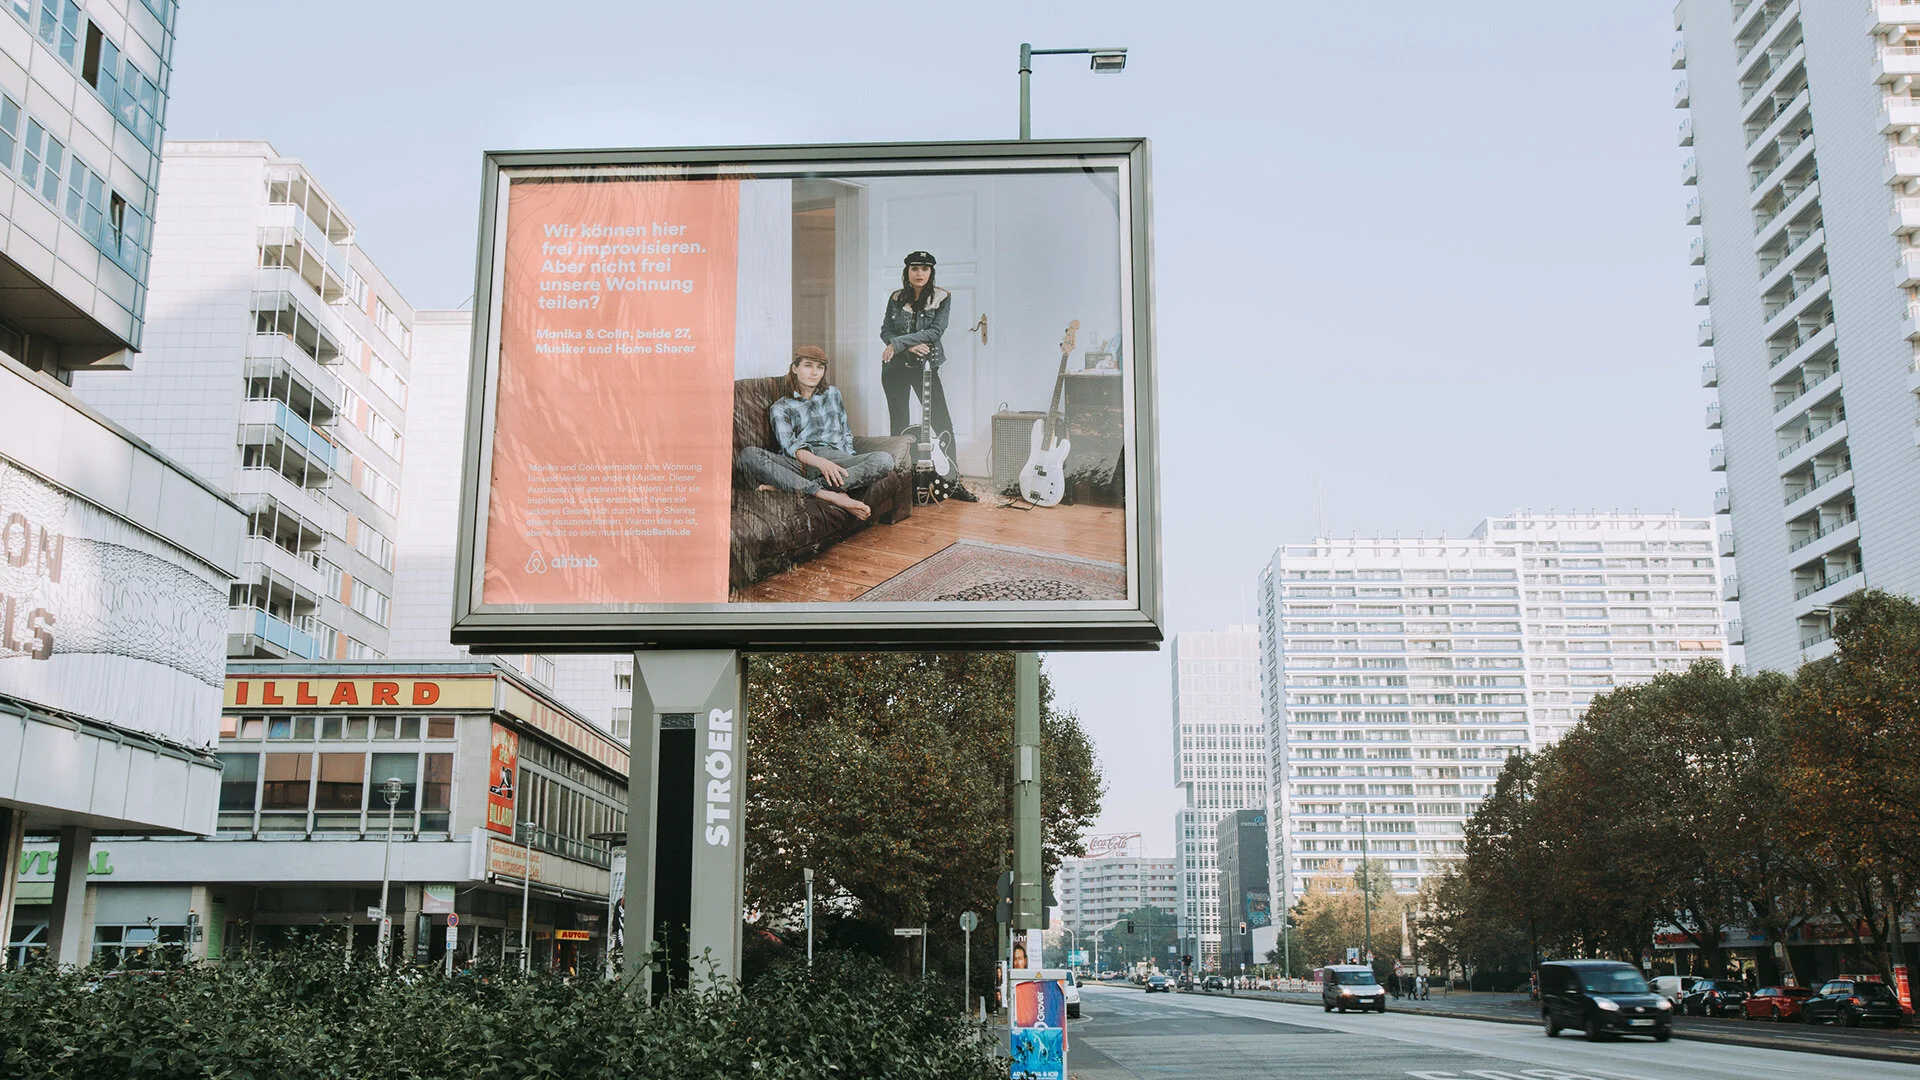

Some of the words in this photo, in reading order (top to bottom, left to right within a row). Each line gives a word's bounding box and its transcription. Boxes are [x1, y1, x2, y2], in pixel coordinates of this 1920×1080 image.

[543, 223, 577, 238] Wir
[580, 223, 646, 237] können
[652, 222, 687, 236] hier
[542, 241, 573, 255] frei
[577, 240, 707, 258] improvisieren.
[540, 259, 586, 273] Aber
[590, 258, 636, 273] nicht
[641, 258, 671, 272] frei
[539, 280, 601, 291] unsere
[606, 277, 693, 293] Wohnung
[537, 295, 600, 309] teilen?
[536, 328, 582, 339] Monika
[585, 329, 594, 339] &
[597, 329, 634, 340] Colin,
[637, 329, 672, 339] beide
[674, 328, 692, 340] 27,
[535, 343, 586, 354] Musiker
[589, 344, 612, 354] und
[615, 343, 652, 354] Home
[655, 343, 696, 353] Sharer
[578, 463, 600, 471] Colin
[662, 463, 703, 472] Wohnung
[669, 473, 695, 481] Dieser
[664, 506, 696, 516] Sharing
[551, 554, 599, 568] airbnb
[0, 592, 56, 661] LS
[705, 708, 733, 847] STRÖER
[20, 850, 115, 876] VIL
[1037, 991, 1045, 1021] Grover
